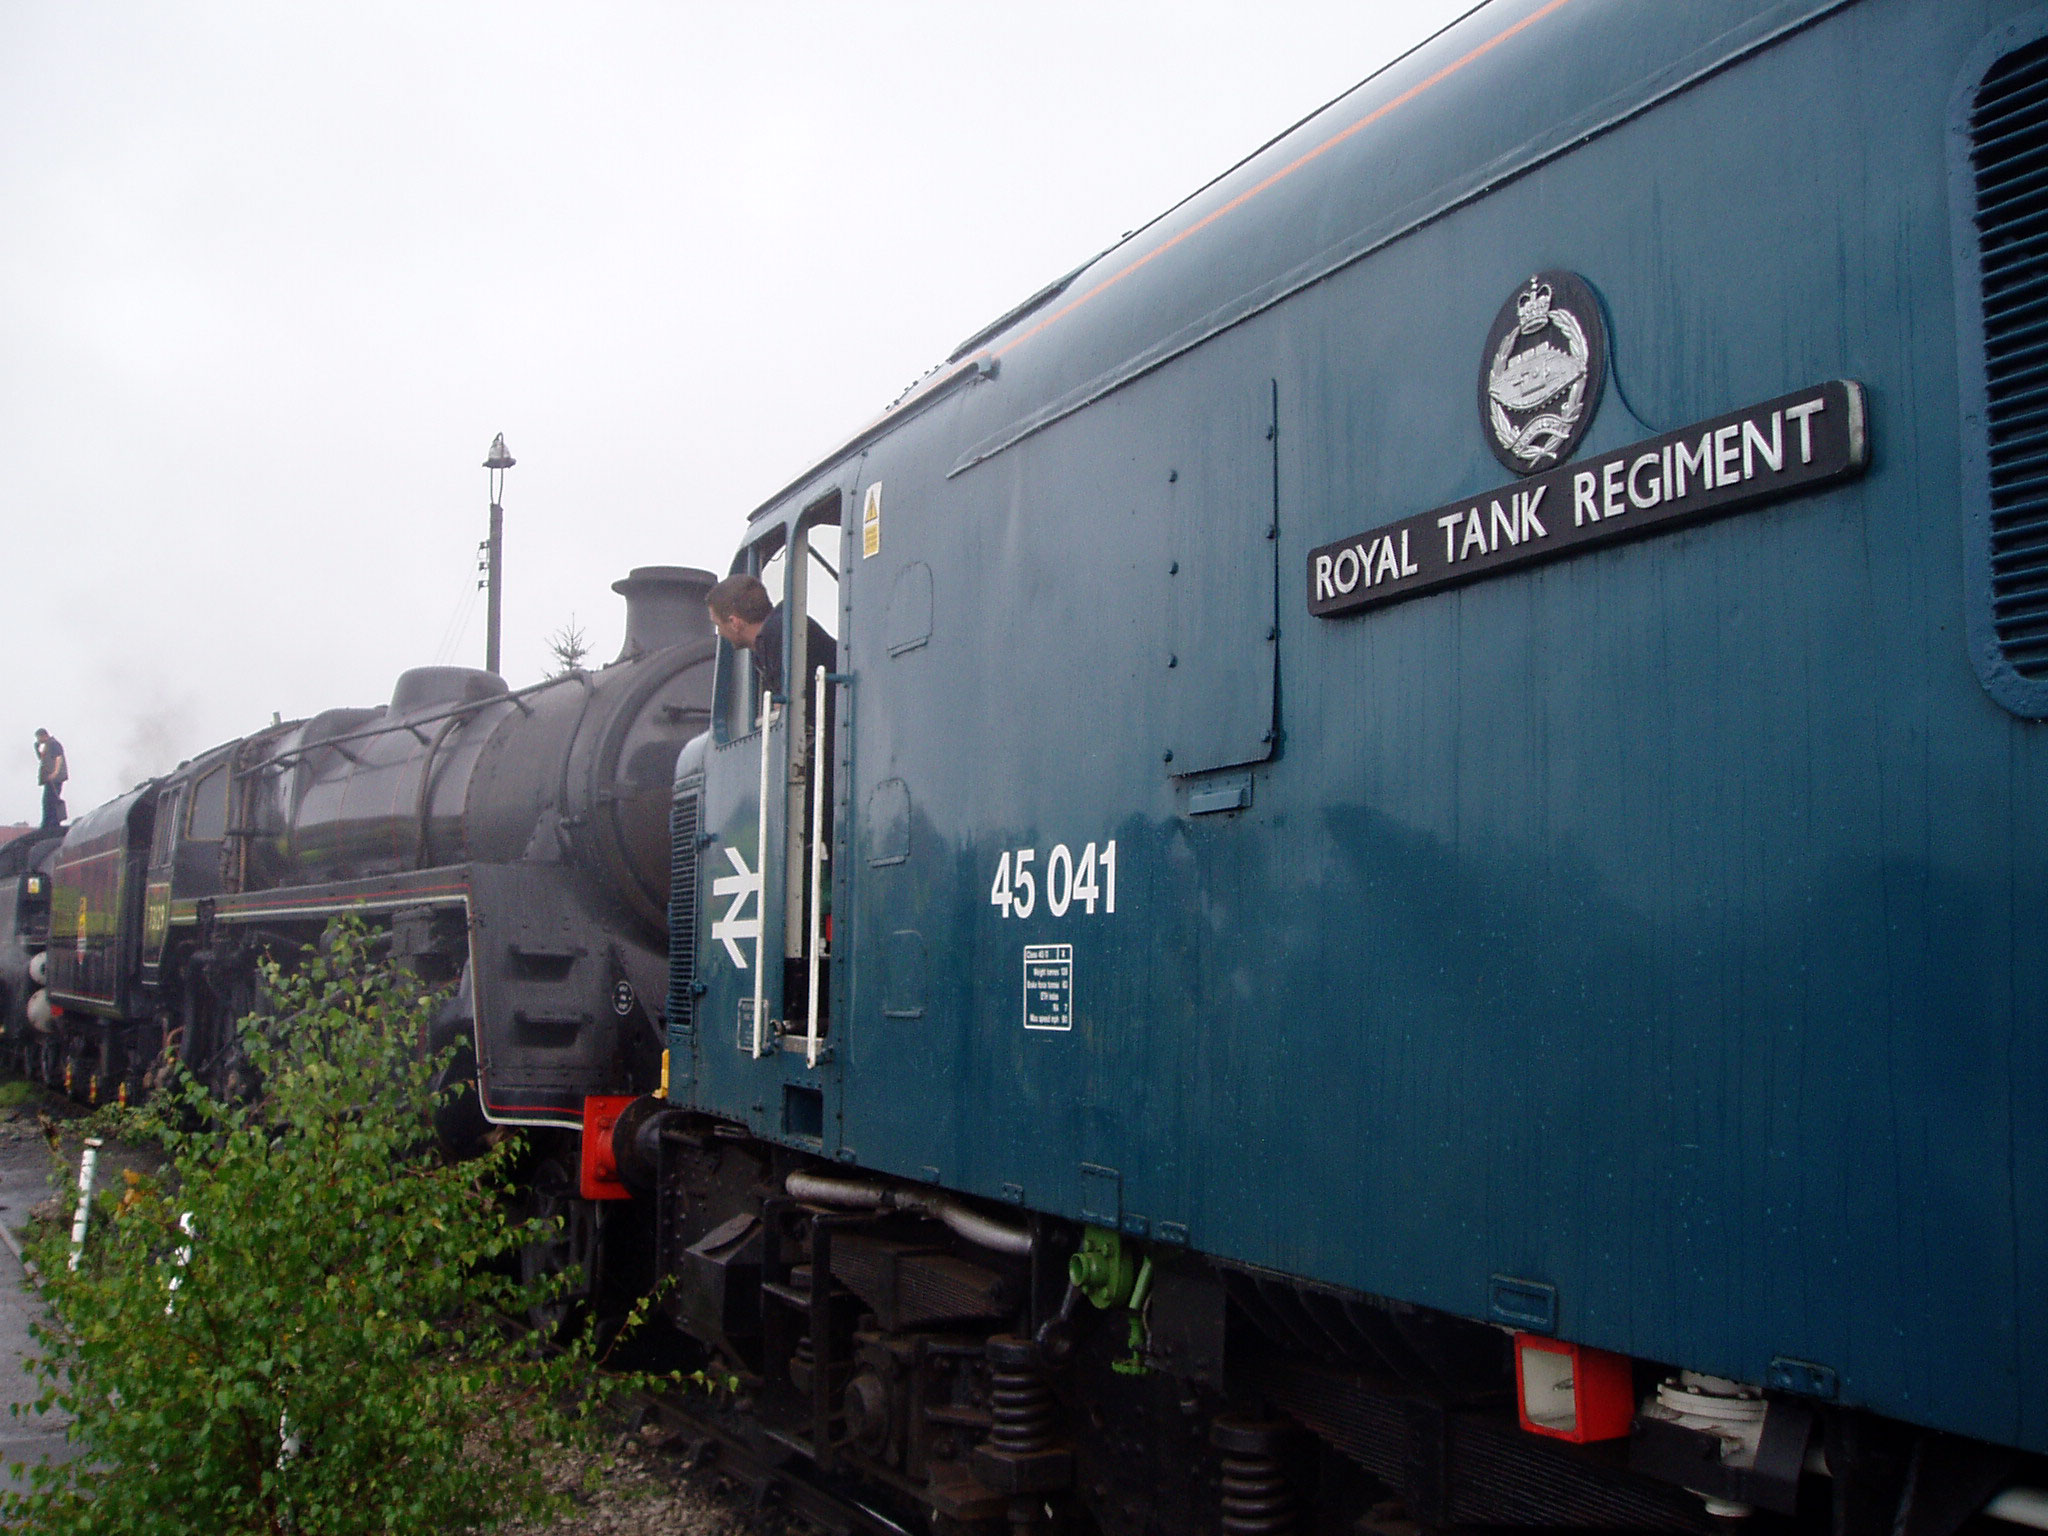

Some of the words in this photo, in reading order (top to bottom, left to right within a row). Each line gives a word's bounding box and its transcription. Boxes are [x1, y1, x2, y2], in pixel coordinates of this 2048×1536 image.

[1316, 529, 1418, 600] ROYAL
[1438, 485, 1549, 563] TANK
[1574, 398, 1824, 527] REGIMENT
[991, 849, 1035, 918] 45
[1047, 840, 1116, 917] 041
